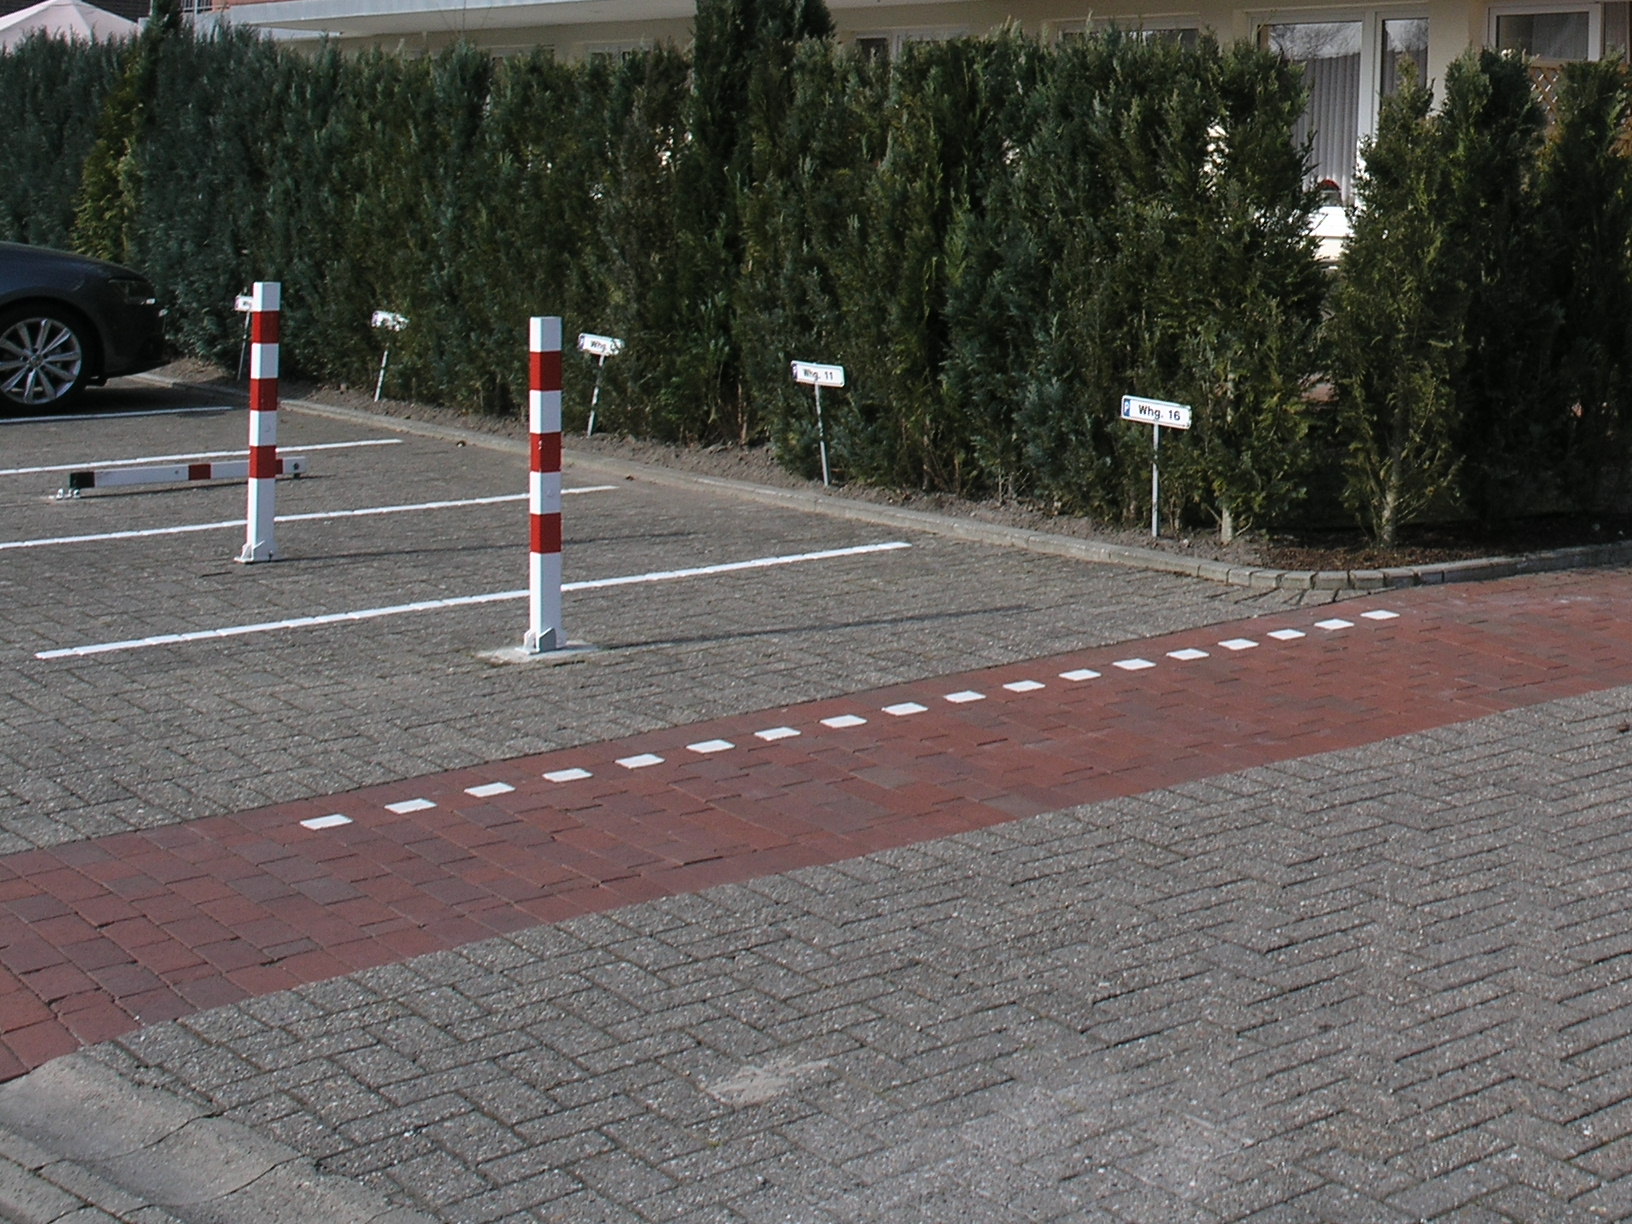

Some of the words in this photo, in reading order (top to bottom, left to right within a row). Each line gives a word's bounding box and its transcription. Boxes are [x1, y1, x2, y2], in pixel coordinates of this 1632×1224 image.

[824, 370, 834, 381] 11
[1138, 404, 1164, 420] Whg.
[1168, 409, 1181, 421] 16
